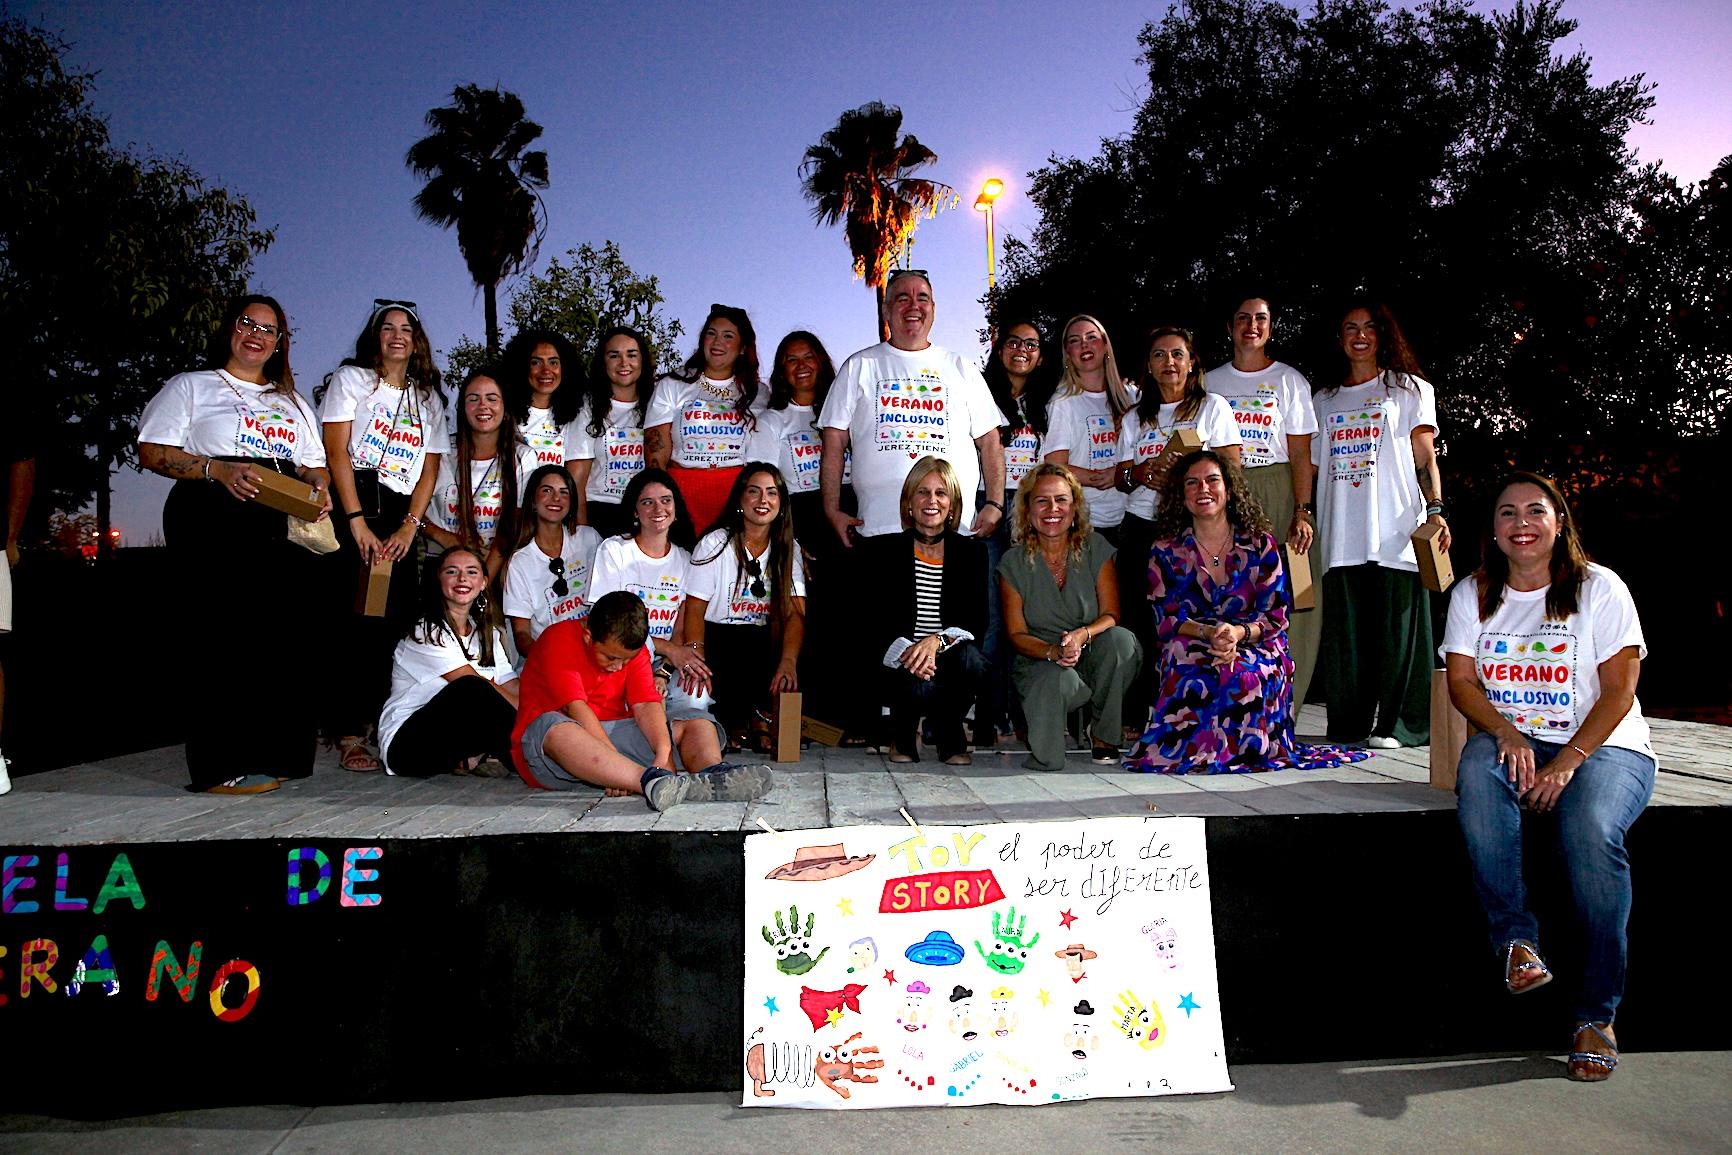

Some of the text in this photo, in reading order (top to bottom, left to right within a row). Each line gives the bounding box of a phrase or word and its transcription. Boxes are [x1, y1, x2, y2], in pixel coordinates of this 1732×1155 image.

[881, 396, 944, 411] VERANO
[684, 410, 742, 421] VERANO
[880, 413, 944, 426] INCLUSIVO
[1234, 412, 1272, 427] RANO
[244, 416, 296, 444] VEANO
[683, 425, 743, 436] INCLUSIVO
[1092, 431, 1116, 445] VER
[1330, 426, 1380, 442] VERANO
[609, 444, 643, 457] VERA
[878, 444, 946, 454] JEREZ TIENE
[1482, 663, 1569, 683] VERANO
[1485, 688, 1570, 706] INCLUSIVO
[887, 831, 1173, 873] TOY el poder de
[2, 846, 384, 914] ELA DE
[891, 878, 991, 910] STORY
[1024, 876, 1070, 898] ser
[0, 934, 261, 1022] RANO
[1120, 1006, 1136, 1031] MARTA
[902, 1043, 924, 1060] LOLA
